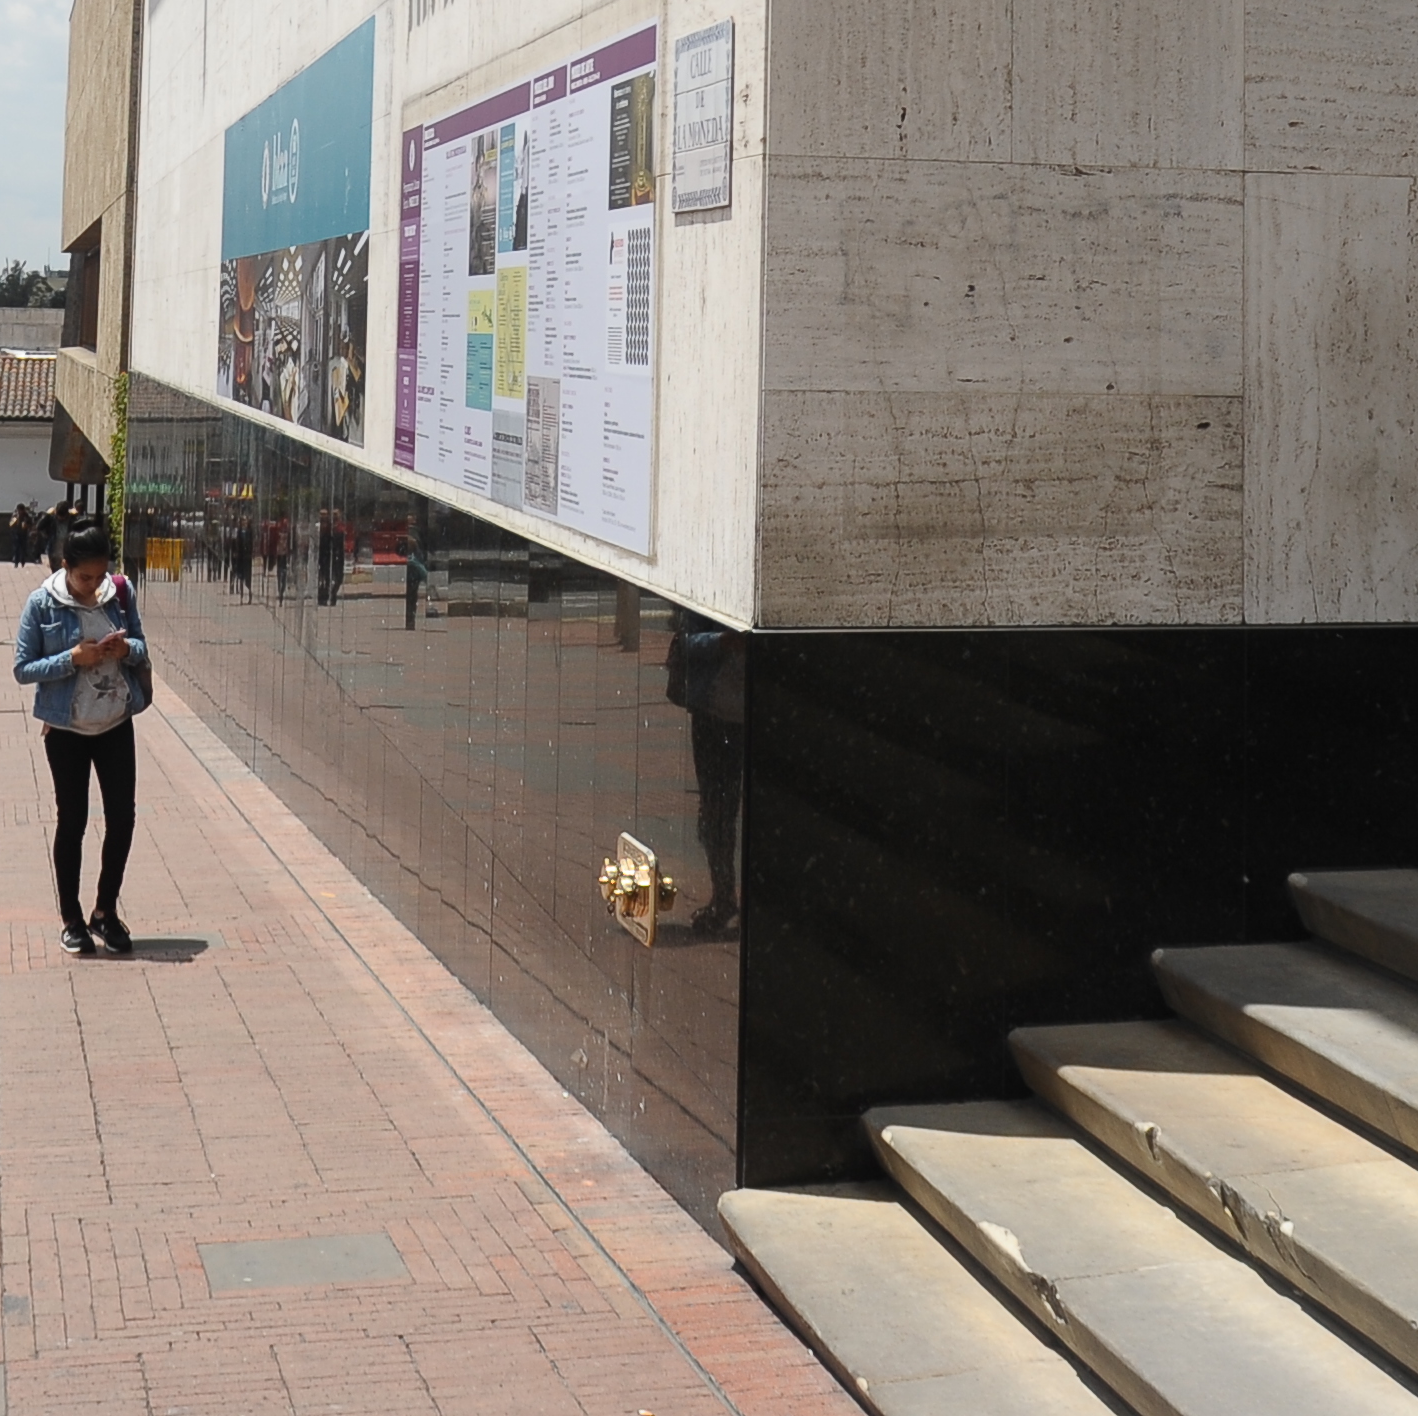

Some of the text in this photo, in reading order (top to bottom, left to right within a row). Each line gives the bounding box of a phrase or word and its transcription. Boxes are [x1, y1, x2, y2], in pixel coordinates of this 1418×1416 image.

[690, 48, 713, 79] CALLE
[695, 90, 705, 109] DE
[688, 115, 724, 148] MONEDA
